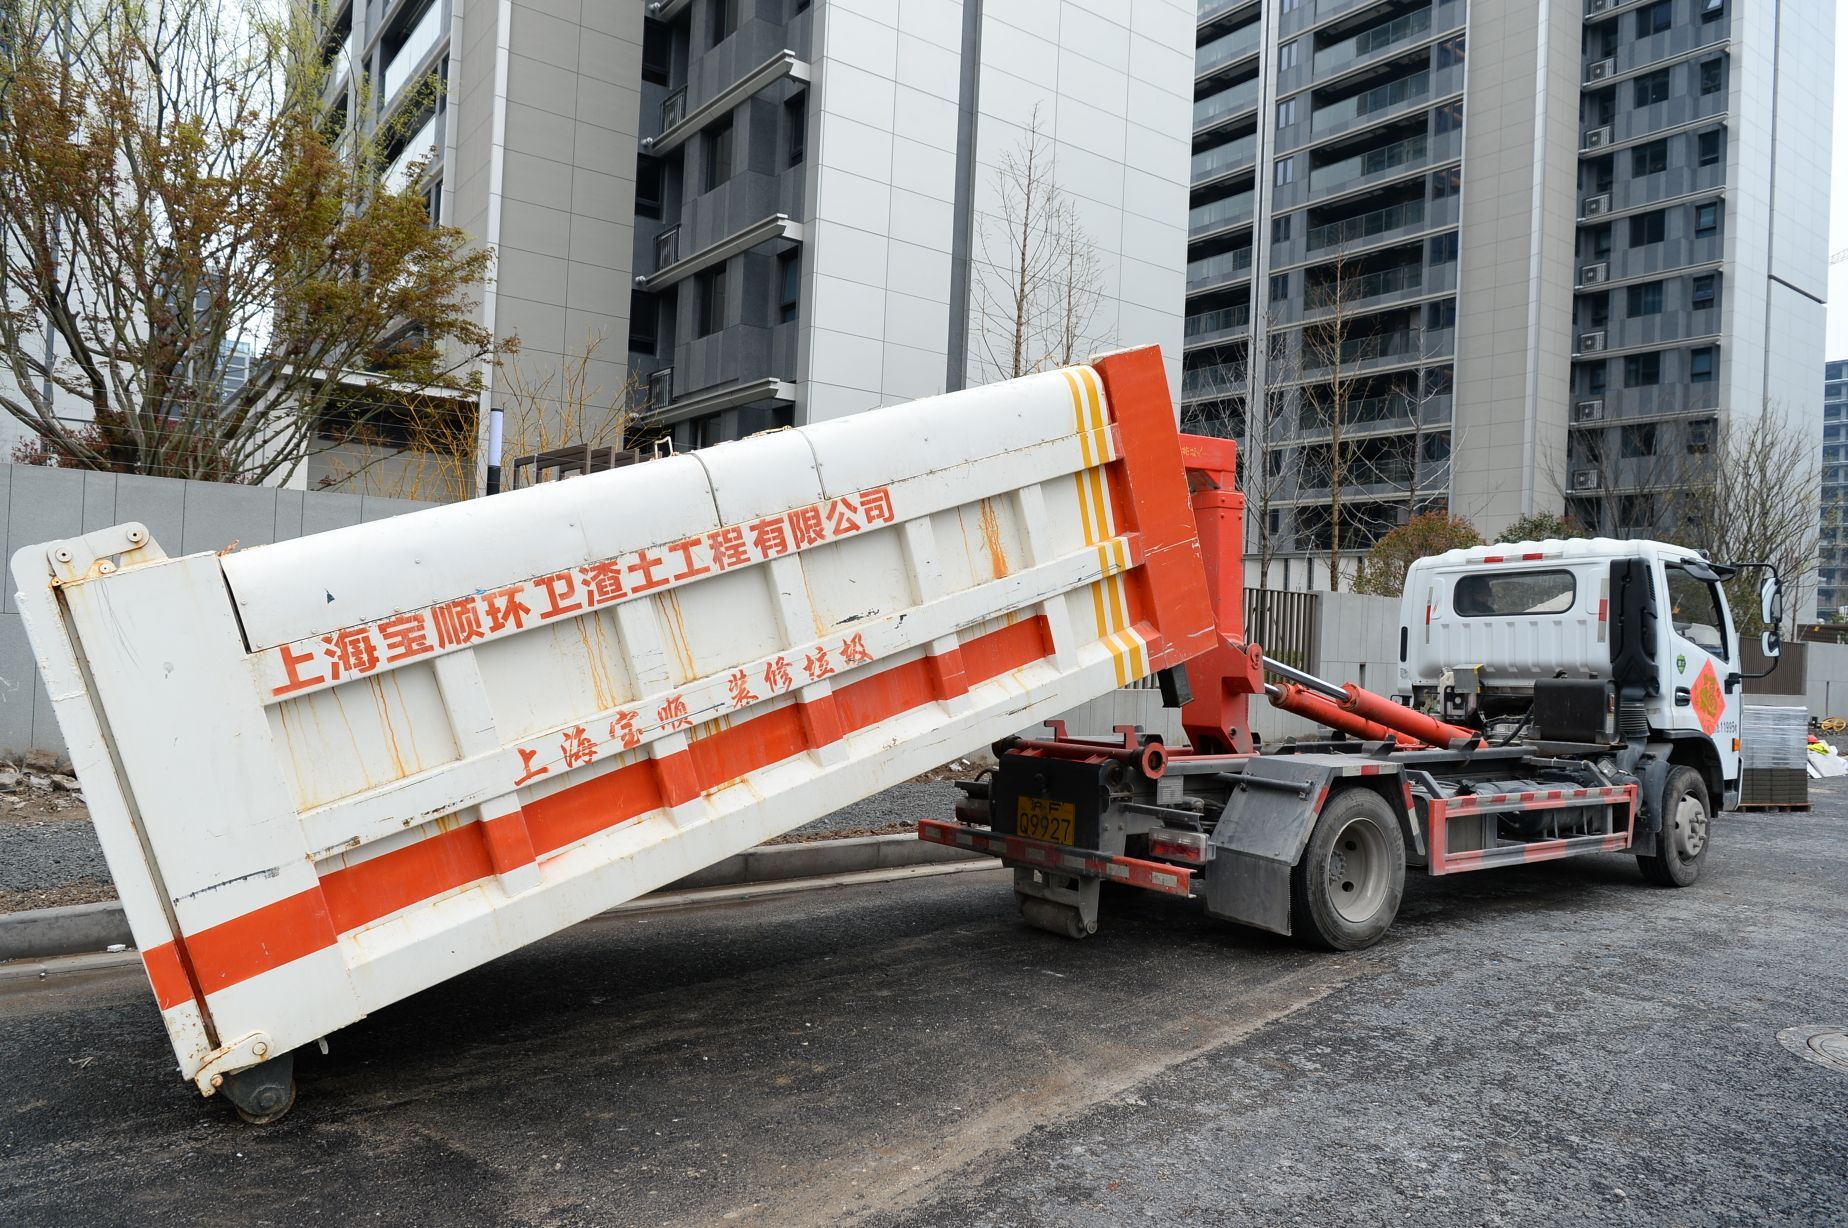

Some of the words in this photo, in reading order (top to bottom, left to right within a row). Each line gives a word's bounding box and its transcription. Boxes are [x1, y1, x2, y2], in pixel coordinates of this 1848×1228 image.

[272, 486, 895, 697] 上海宝顺环卫渣土工程有限公司
[513, 692, 694, 787] 上海宝顺
[1020, 812, 1071, 841] Q9927
